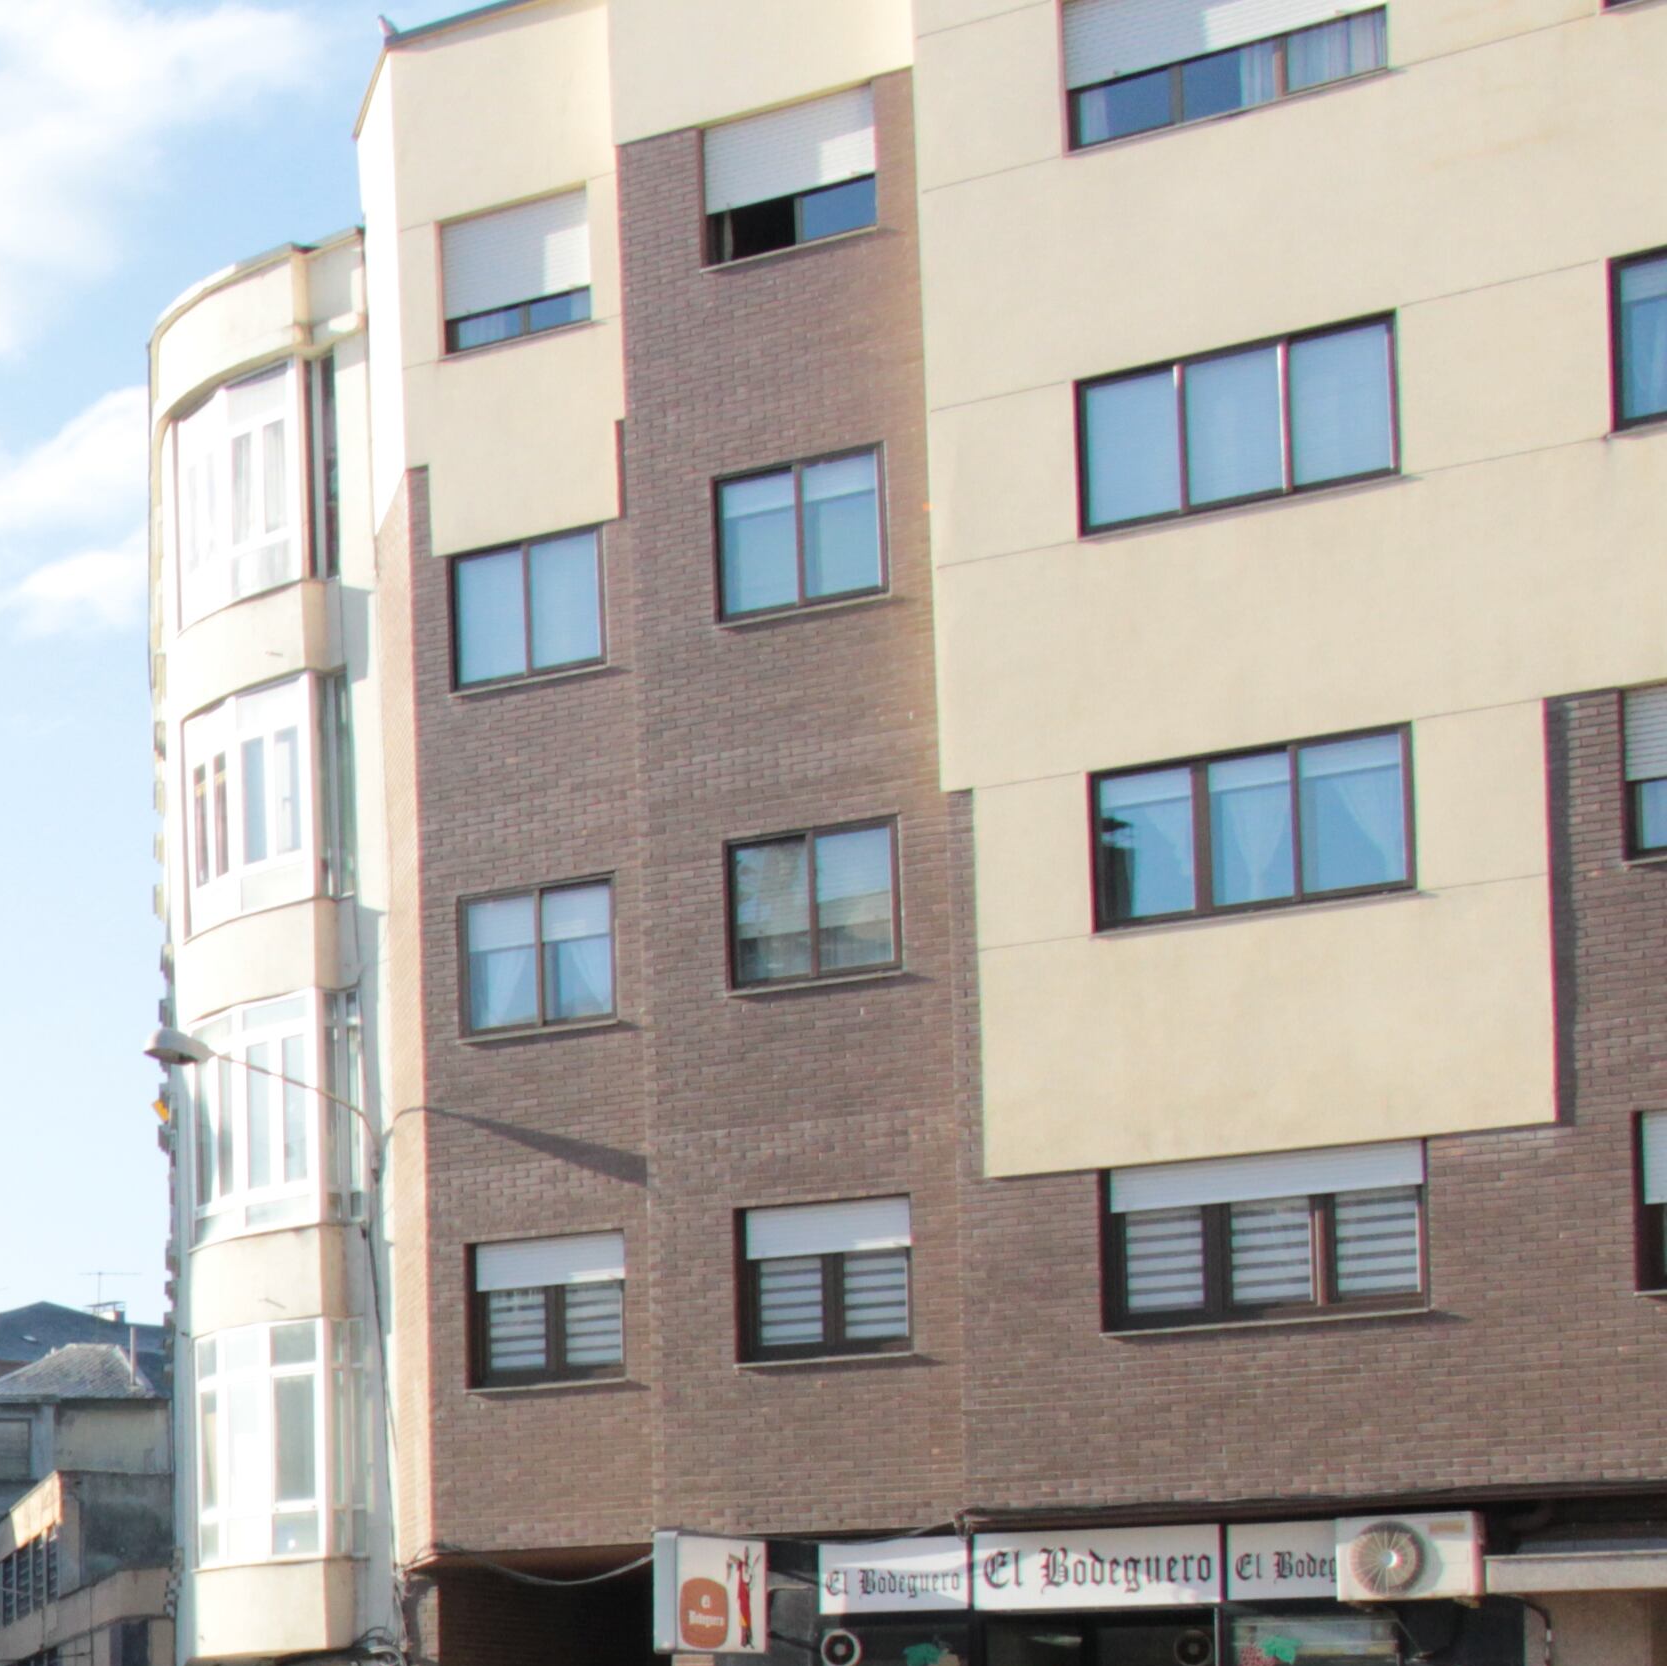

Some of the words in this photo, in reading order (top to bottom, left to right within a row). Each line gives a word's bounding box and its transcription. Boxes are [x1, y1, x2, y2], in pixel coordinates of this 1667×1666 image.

[826, 1571, 849, 1596] El
[857, 1568, 961, 1598] Bodeguero
[983, 1550, 1022, 1590] El
[1038, 1547, 1211, 1595] Bodeguero
[1234, 1552, 1262, 1581] El
[1273, 1551, 1337, 1584] Bodeg
